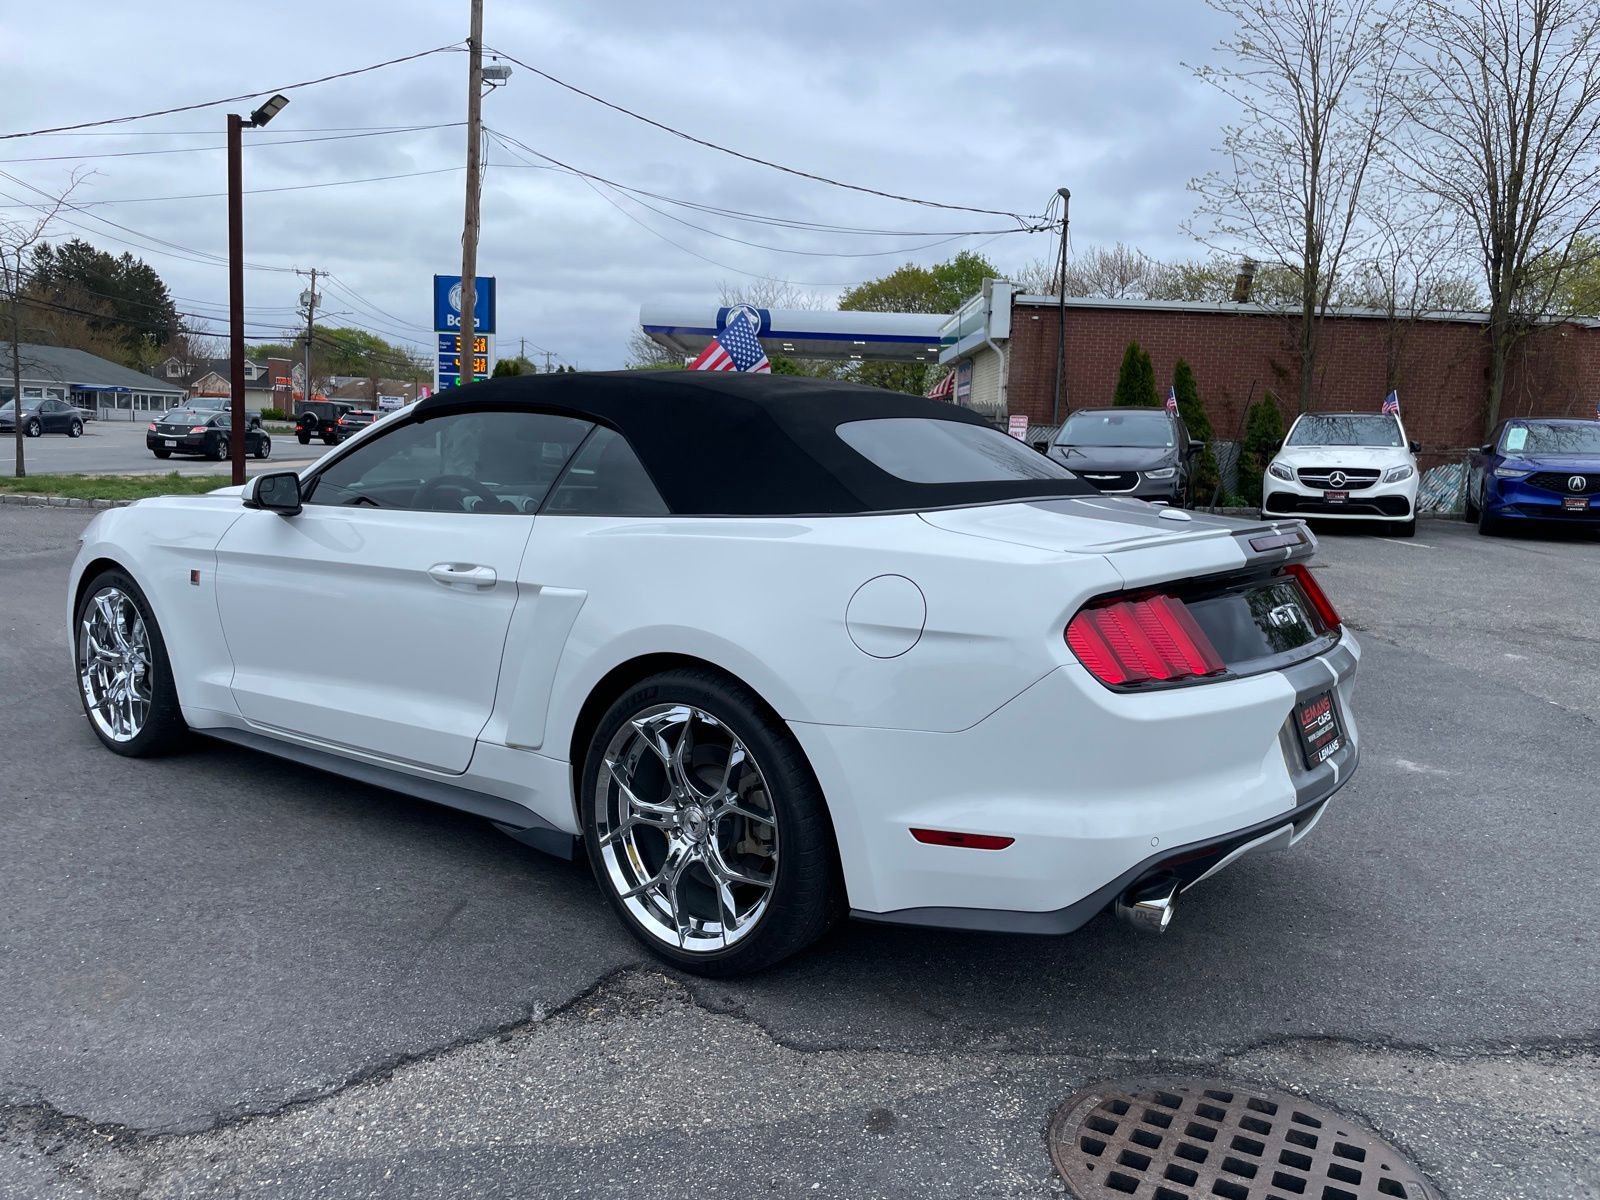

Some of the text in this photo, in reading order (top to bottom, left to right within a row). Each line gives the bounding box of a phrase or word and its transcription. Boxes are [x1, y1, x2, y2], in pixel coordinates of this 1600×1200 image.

[447, 314, 480, 327] Boa
[1300, 696, 1331, 726] LEMANS
[1317, 710, 1332, 726] CARS
[1318, 739, 1340, 762] LEMANS
